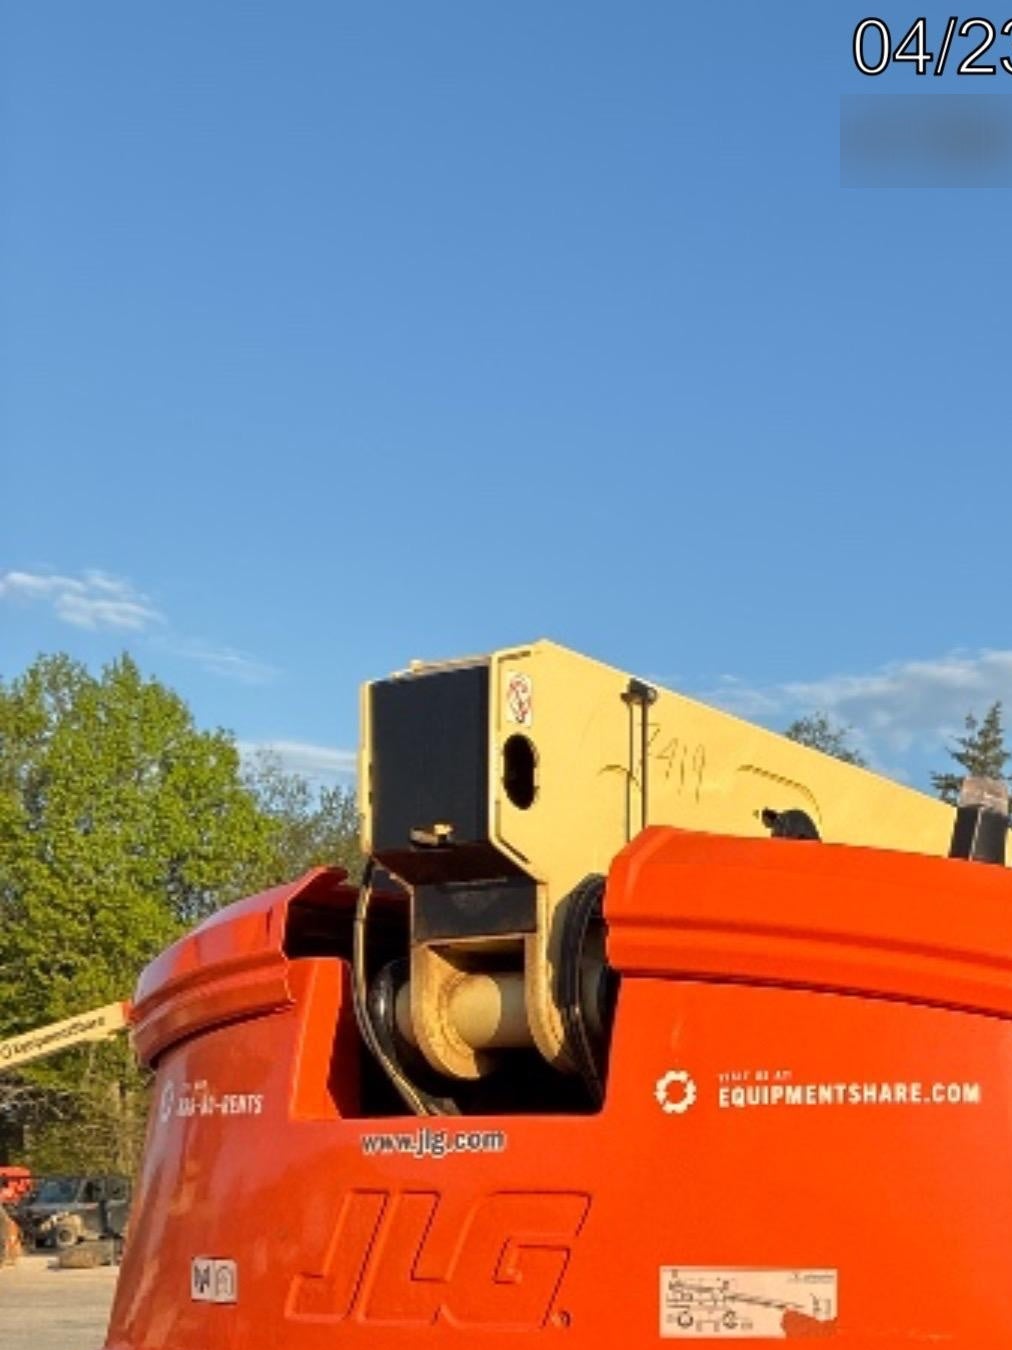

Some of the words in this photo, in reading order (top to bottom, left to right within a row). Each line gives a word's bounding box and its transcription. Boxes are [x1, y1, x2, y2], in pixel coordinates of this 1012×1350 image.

[717, 1081, 981, 1109] EQUIPMENTSHARE.COM
[360, 1128, 506, 1157] www.jlg.com
[284, 1187, 592, 1331] JLG
